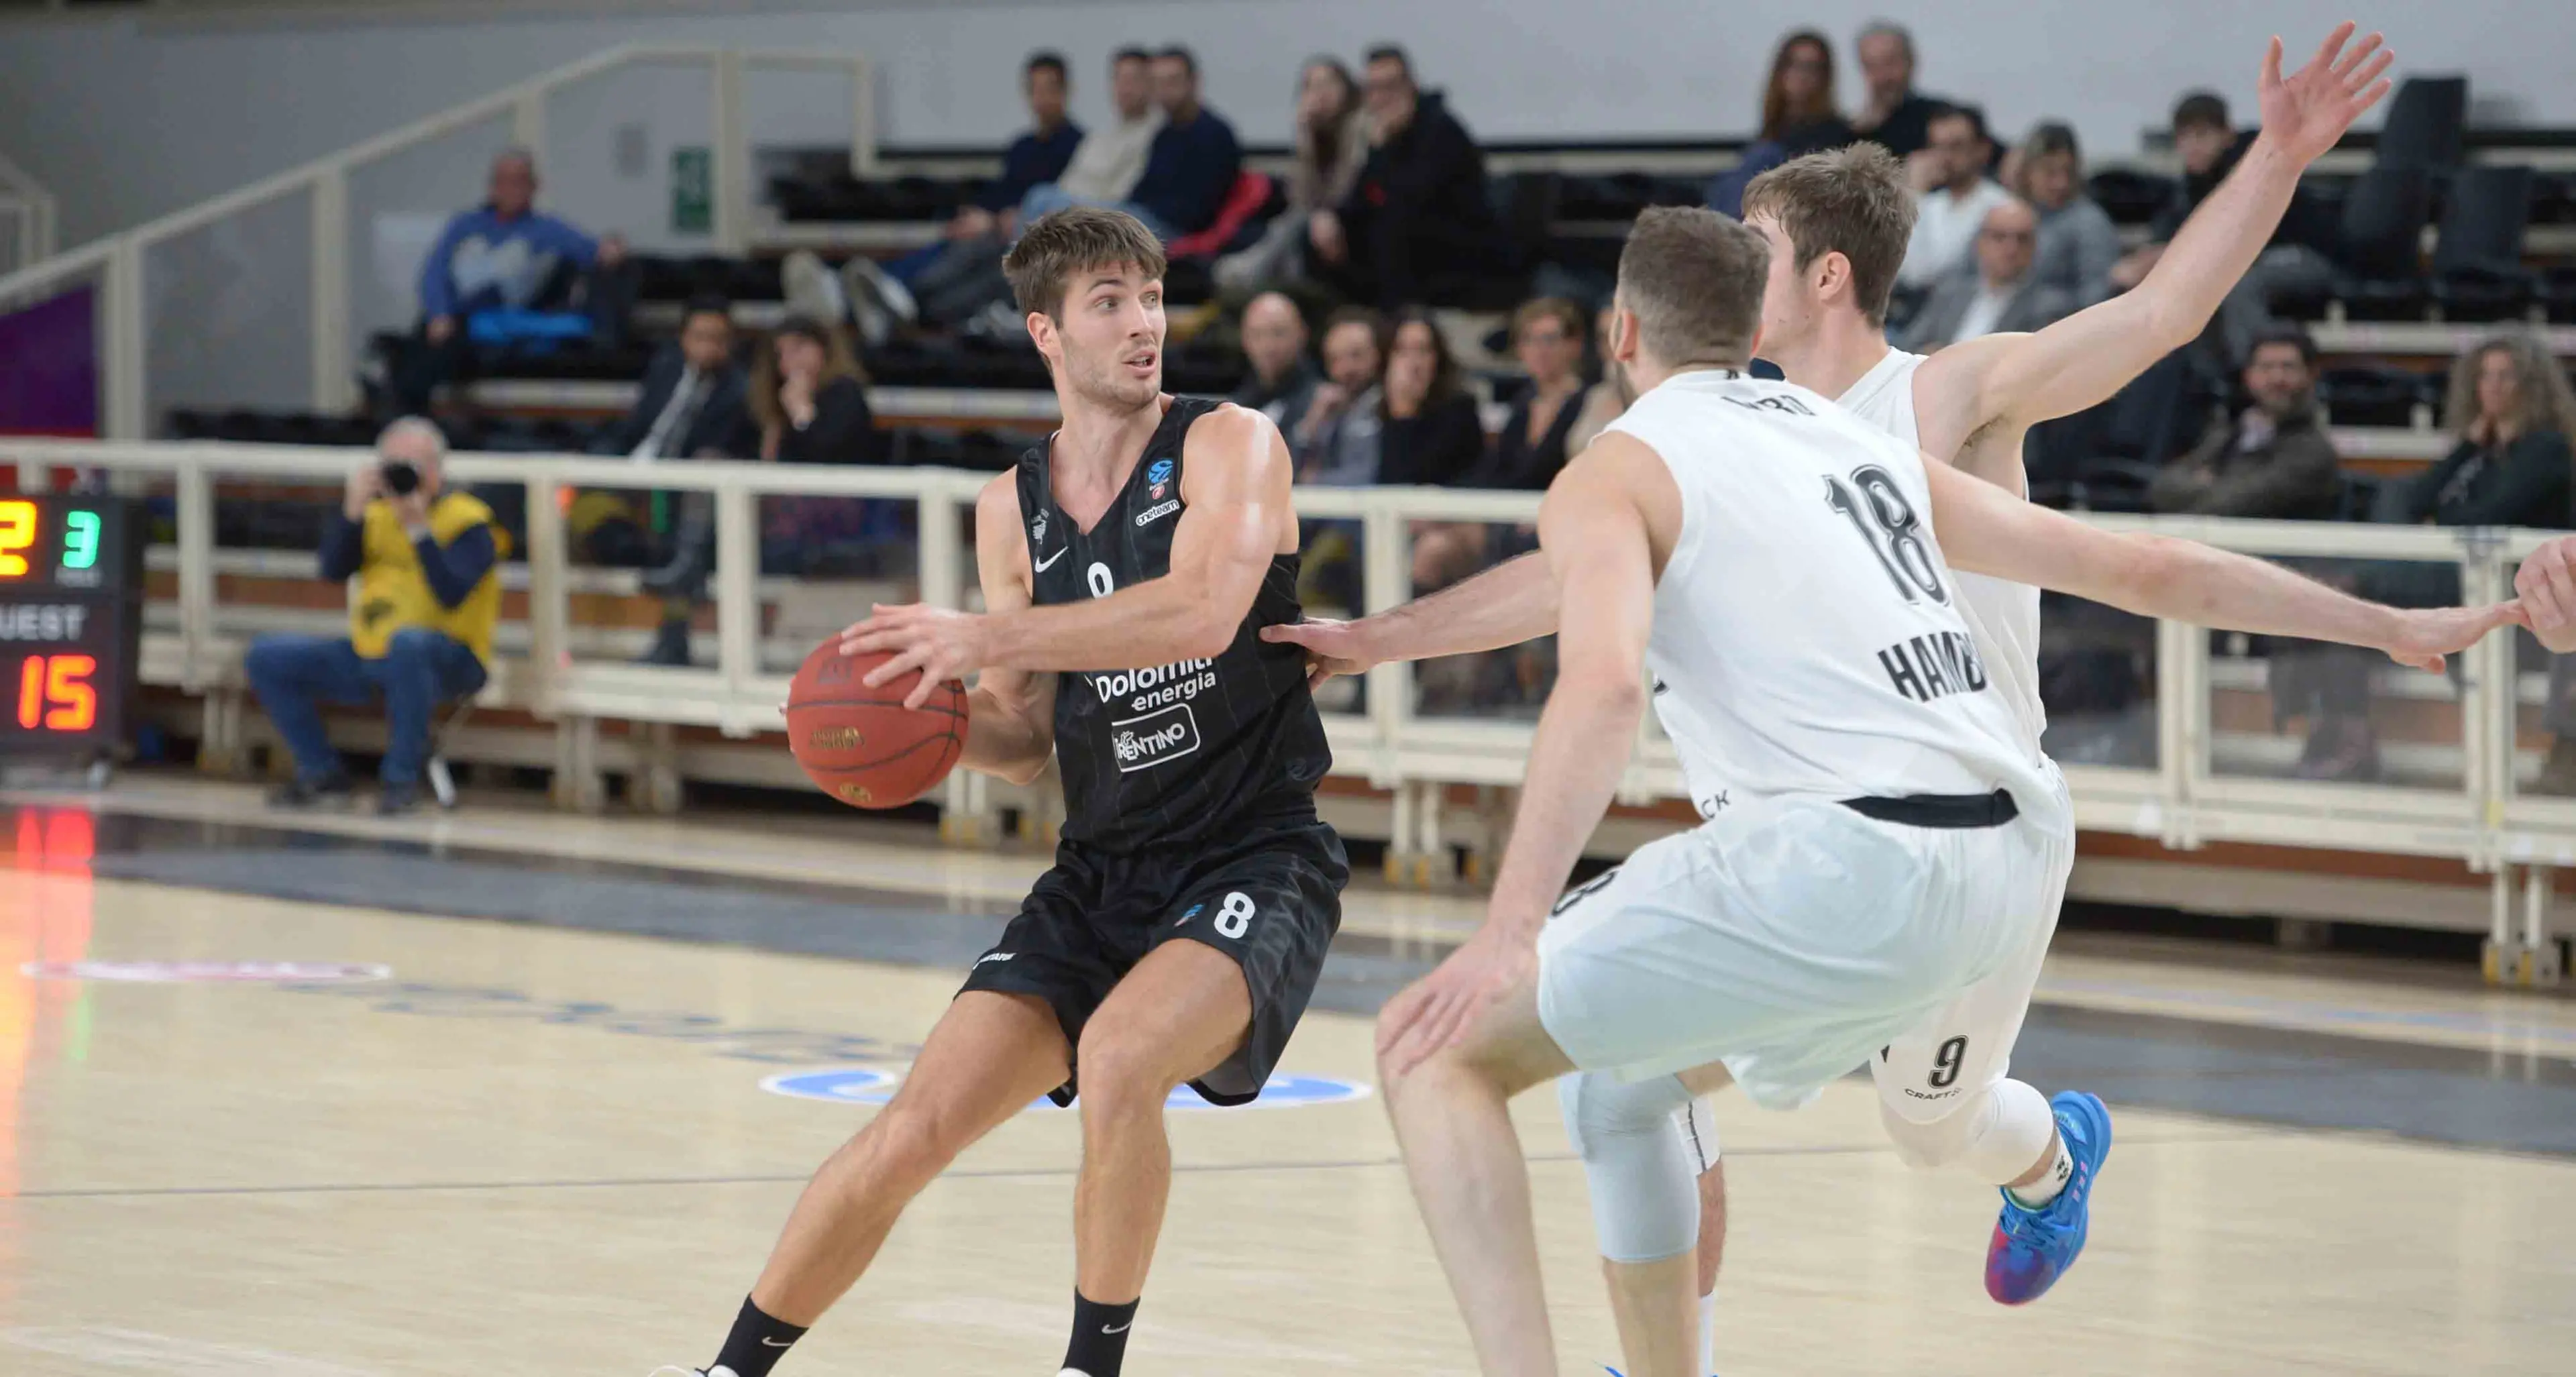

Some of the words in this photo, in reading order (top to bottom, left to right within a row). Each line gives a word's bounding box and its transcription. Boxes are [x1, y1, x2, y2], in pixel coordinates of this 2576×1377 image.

[63, 511, 101, 568] 3
[1821, 463, 1950, 606] 18
[18, 655, 97, 730] 15
[1131, 672, 1216, 712] energia
[1214, 891, 1256, 939] 8
[1927, 1034, 1969, 1089] 9
